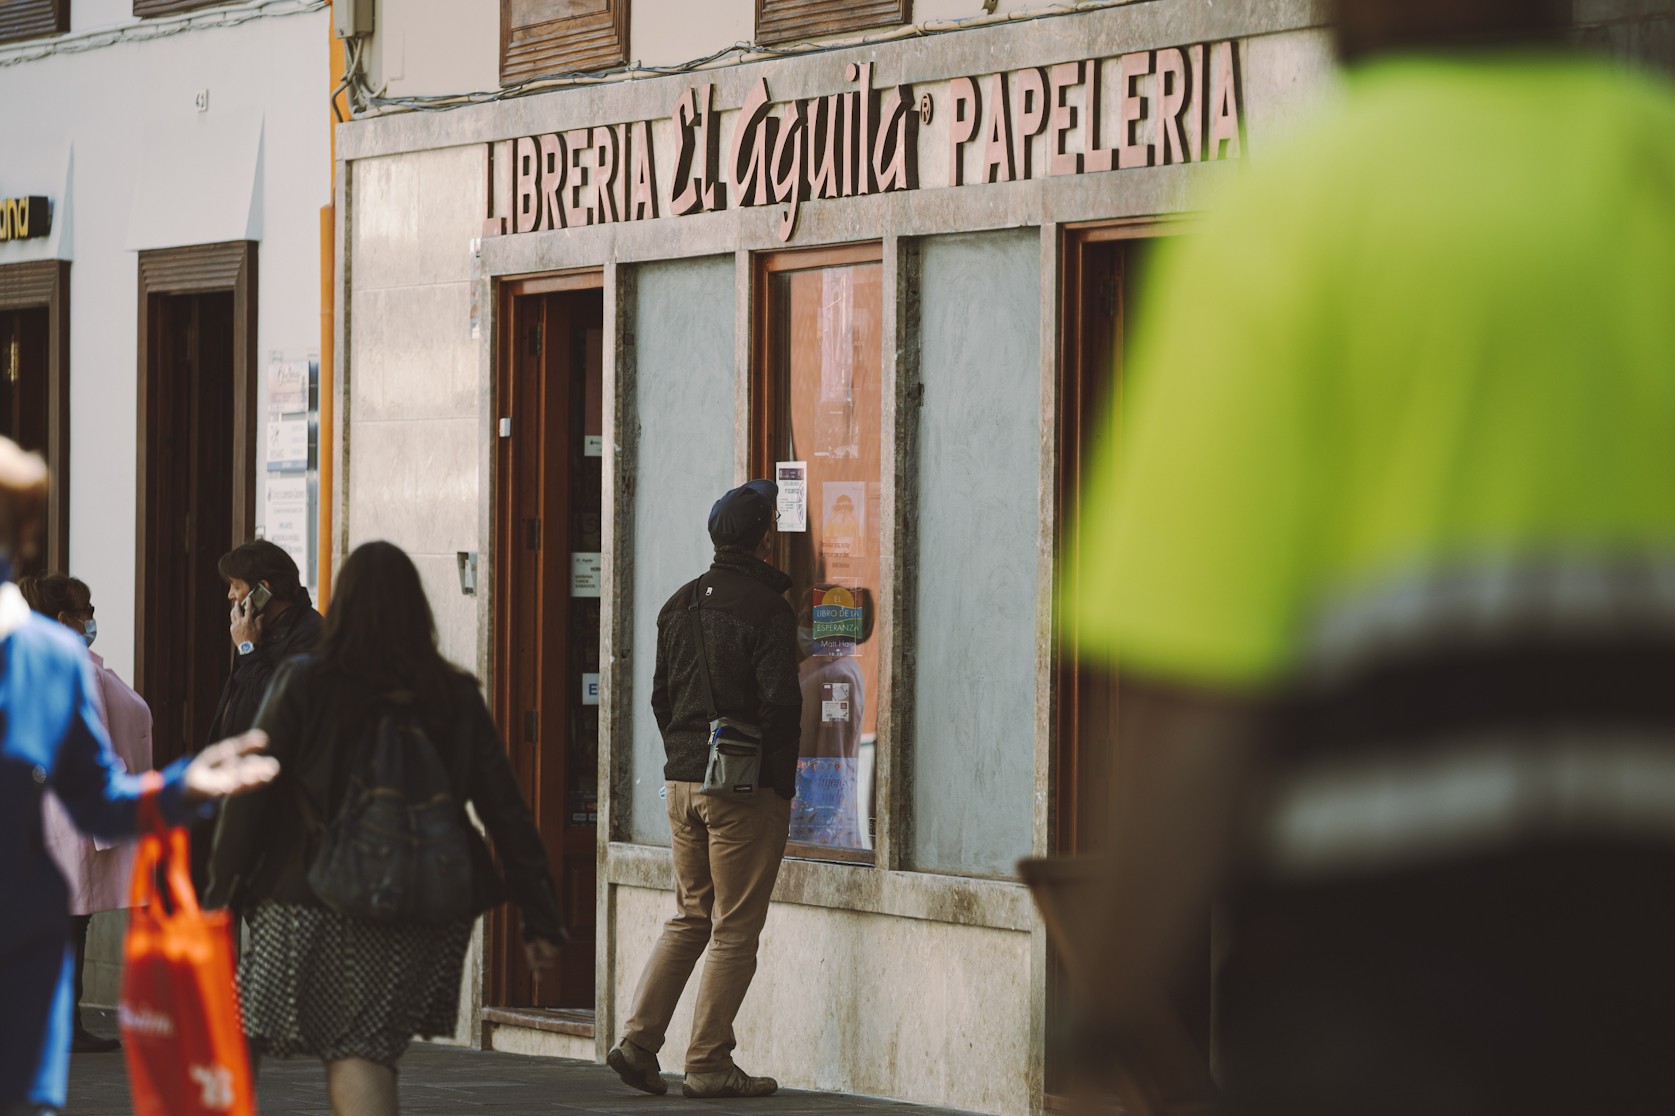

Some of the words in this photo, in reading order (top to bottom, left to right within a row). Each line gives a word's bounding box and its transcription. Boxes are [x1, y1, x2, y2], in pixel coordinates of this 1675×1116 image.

[482, 120, 659, 236] LIBRERIA
[670, 83, 727, 216] El
[948, 41, 1247, 188] PAPELERIA
[838, 640, 856, 649] Haig
